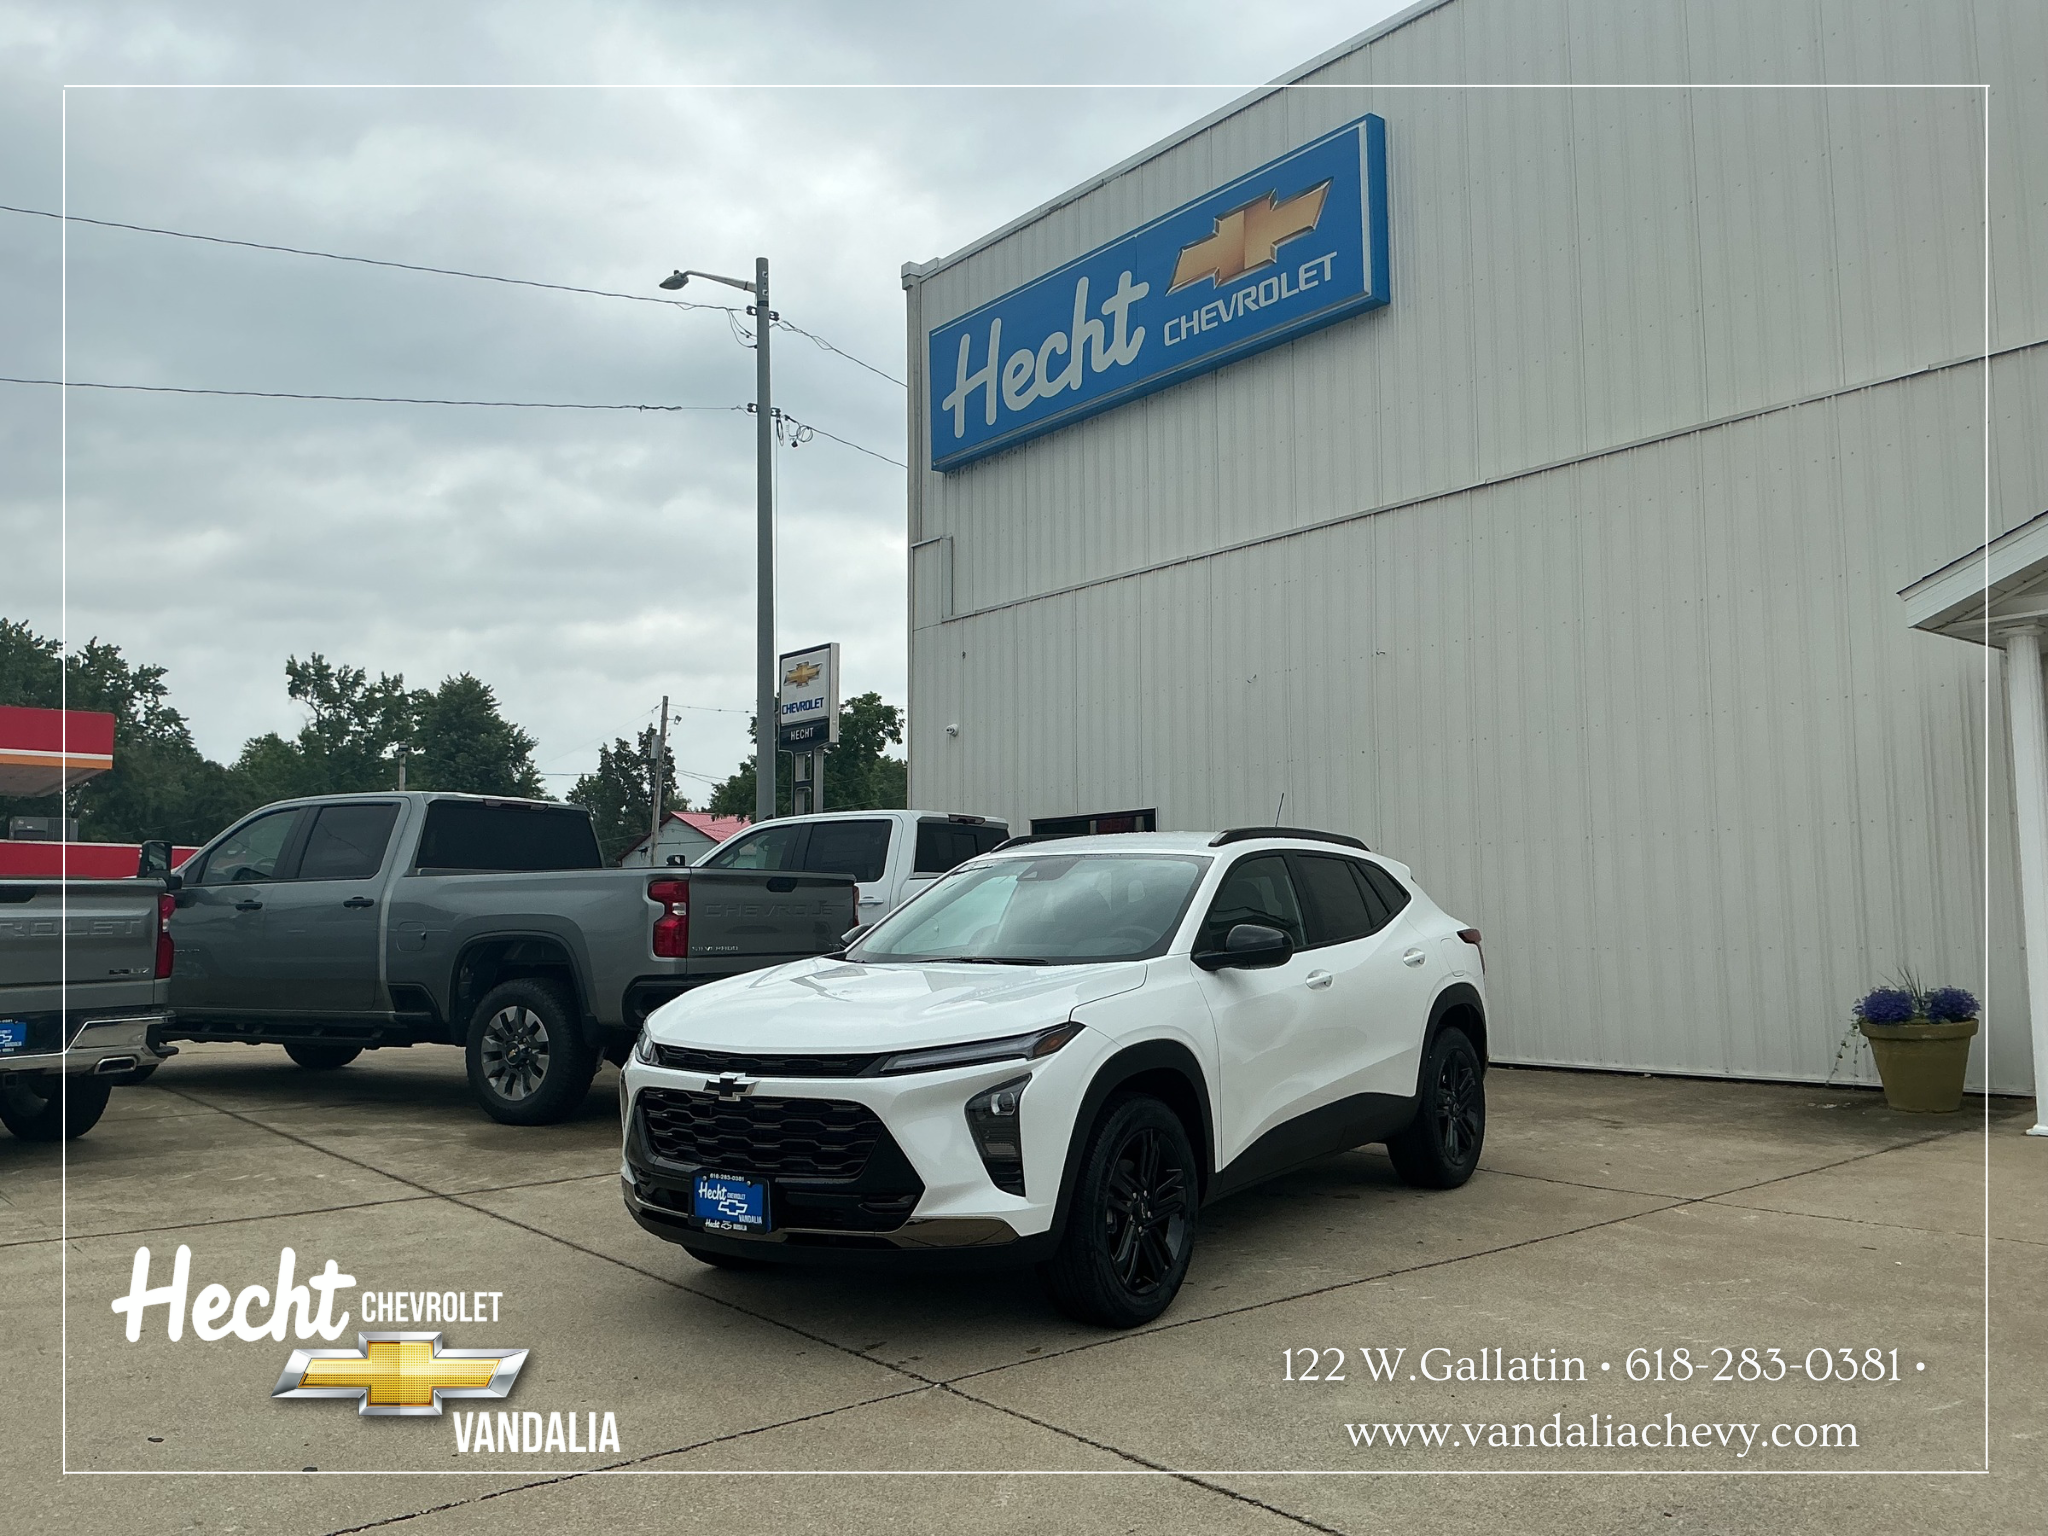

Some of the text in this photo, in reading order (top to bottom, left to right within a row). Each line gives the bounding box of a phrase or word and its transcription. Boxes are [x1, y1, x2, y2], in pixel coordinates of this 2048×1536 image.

[942, 251, 1338, 438] Hecht CHEVROLET
[781, 697, 825, 715] CHEVROLET
[790, 727, 814, 741] HECHT
[698, 1181, 727, 1201] Hecht
[738, 1214, 762, 1225] VANDALIA
